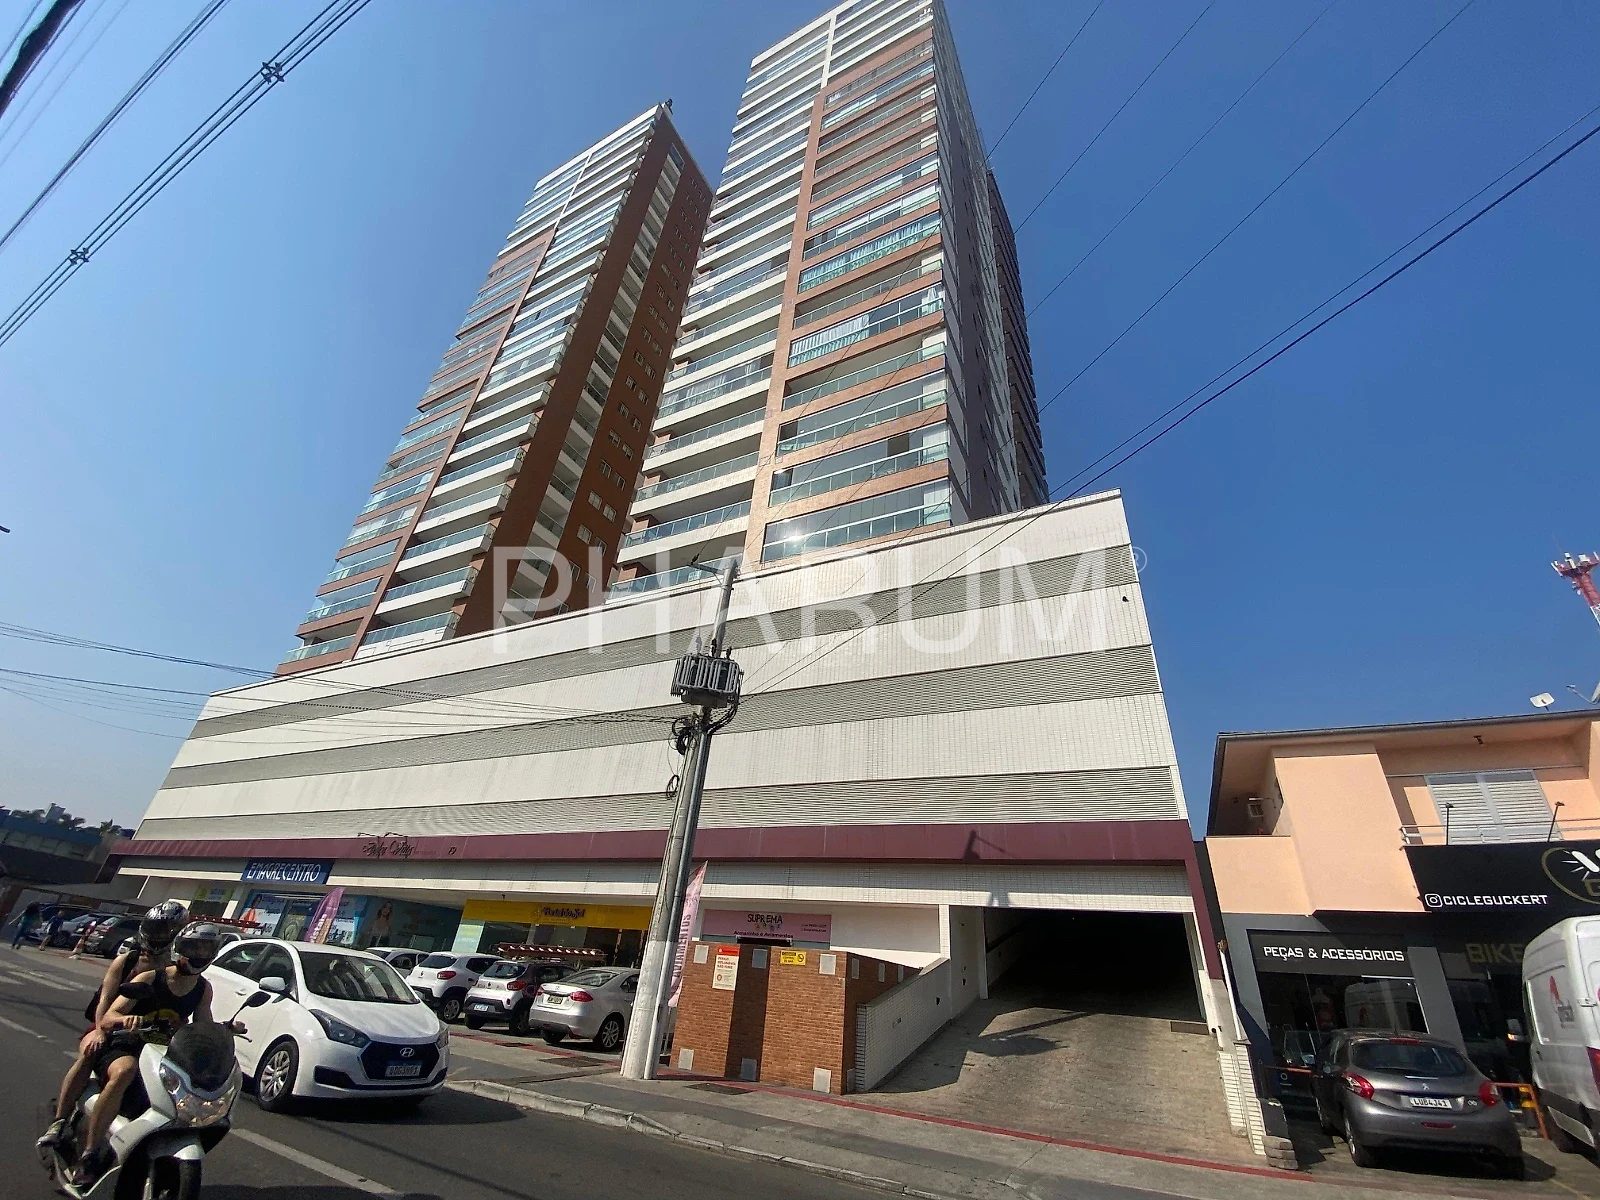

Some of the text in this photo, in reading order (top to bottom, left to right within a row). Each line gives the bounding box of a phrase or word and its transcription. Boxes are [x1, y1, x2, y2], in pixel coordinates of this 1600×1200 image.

[246, 862, 321, 881] EMAGRECENTRO
[1442, 894, 1548, 907] CICLEGUCKERT
[747, 913, 783, 924] SUPREMA
[1263, 946, 1404, 962] PEÇAS & ACESSÓRIOS
